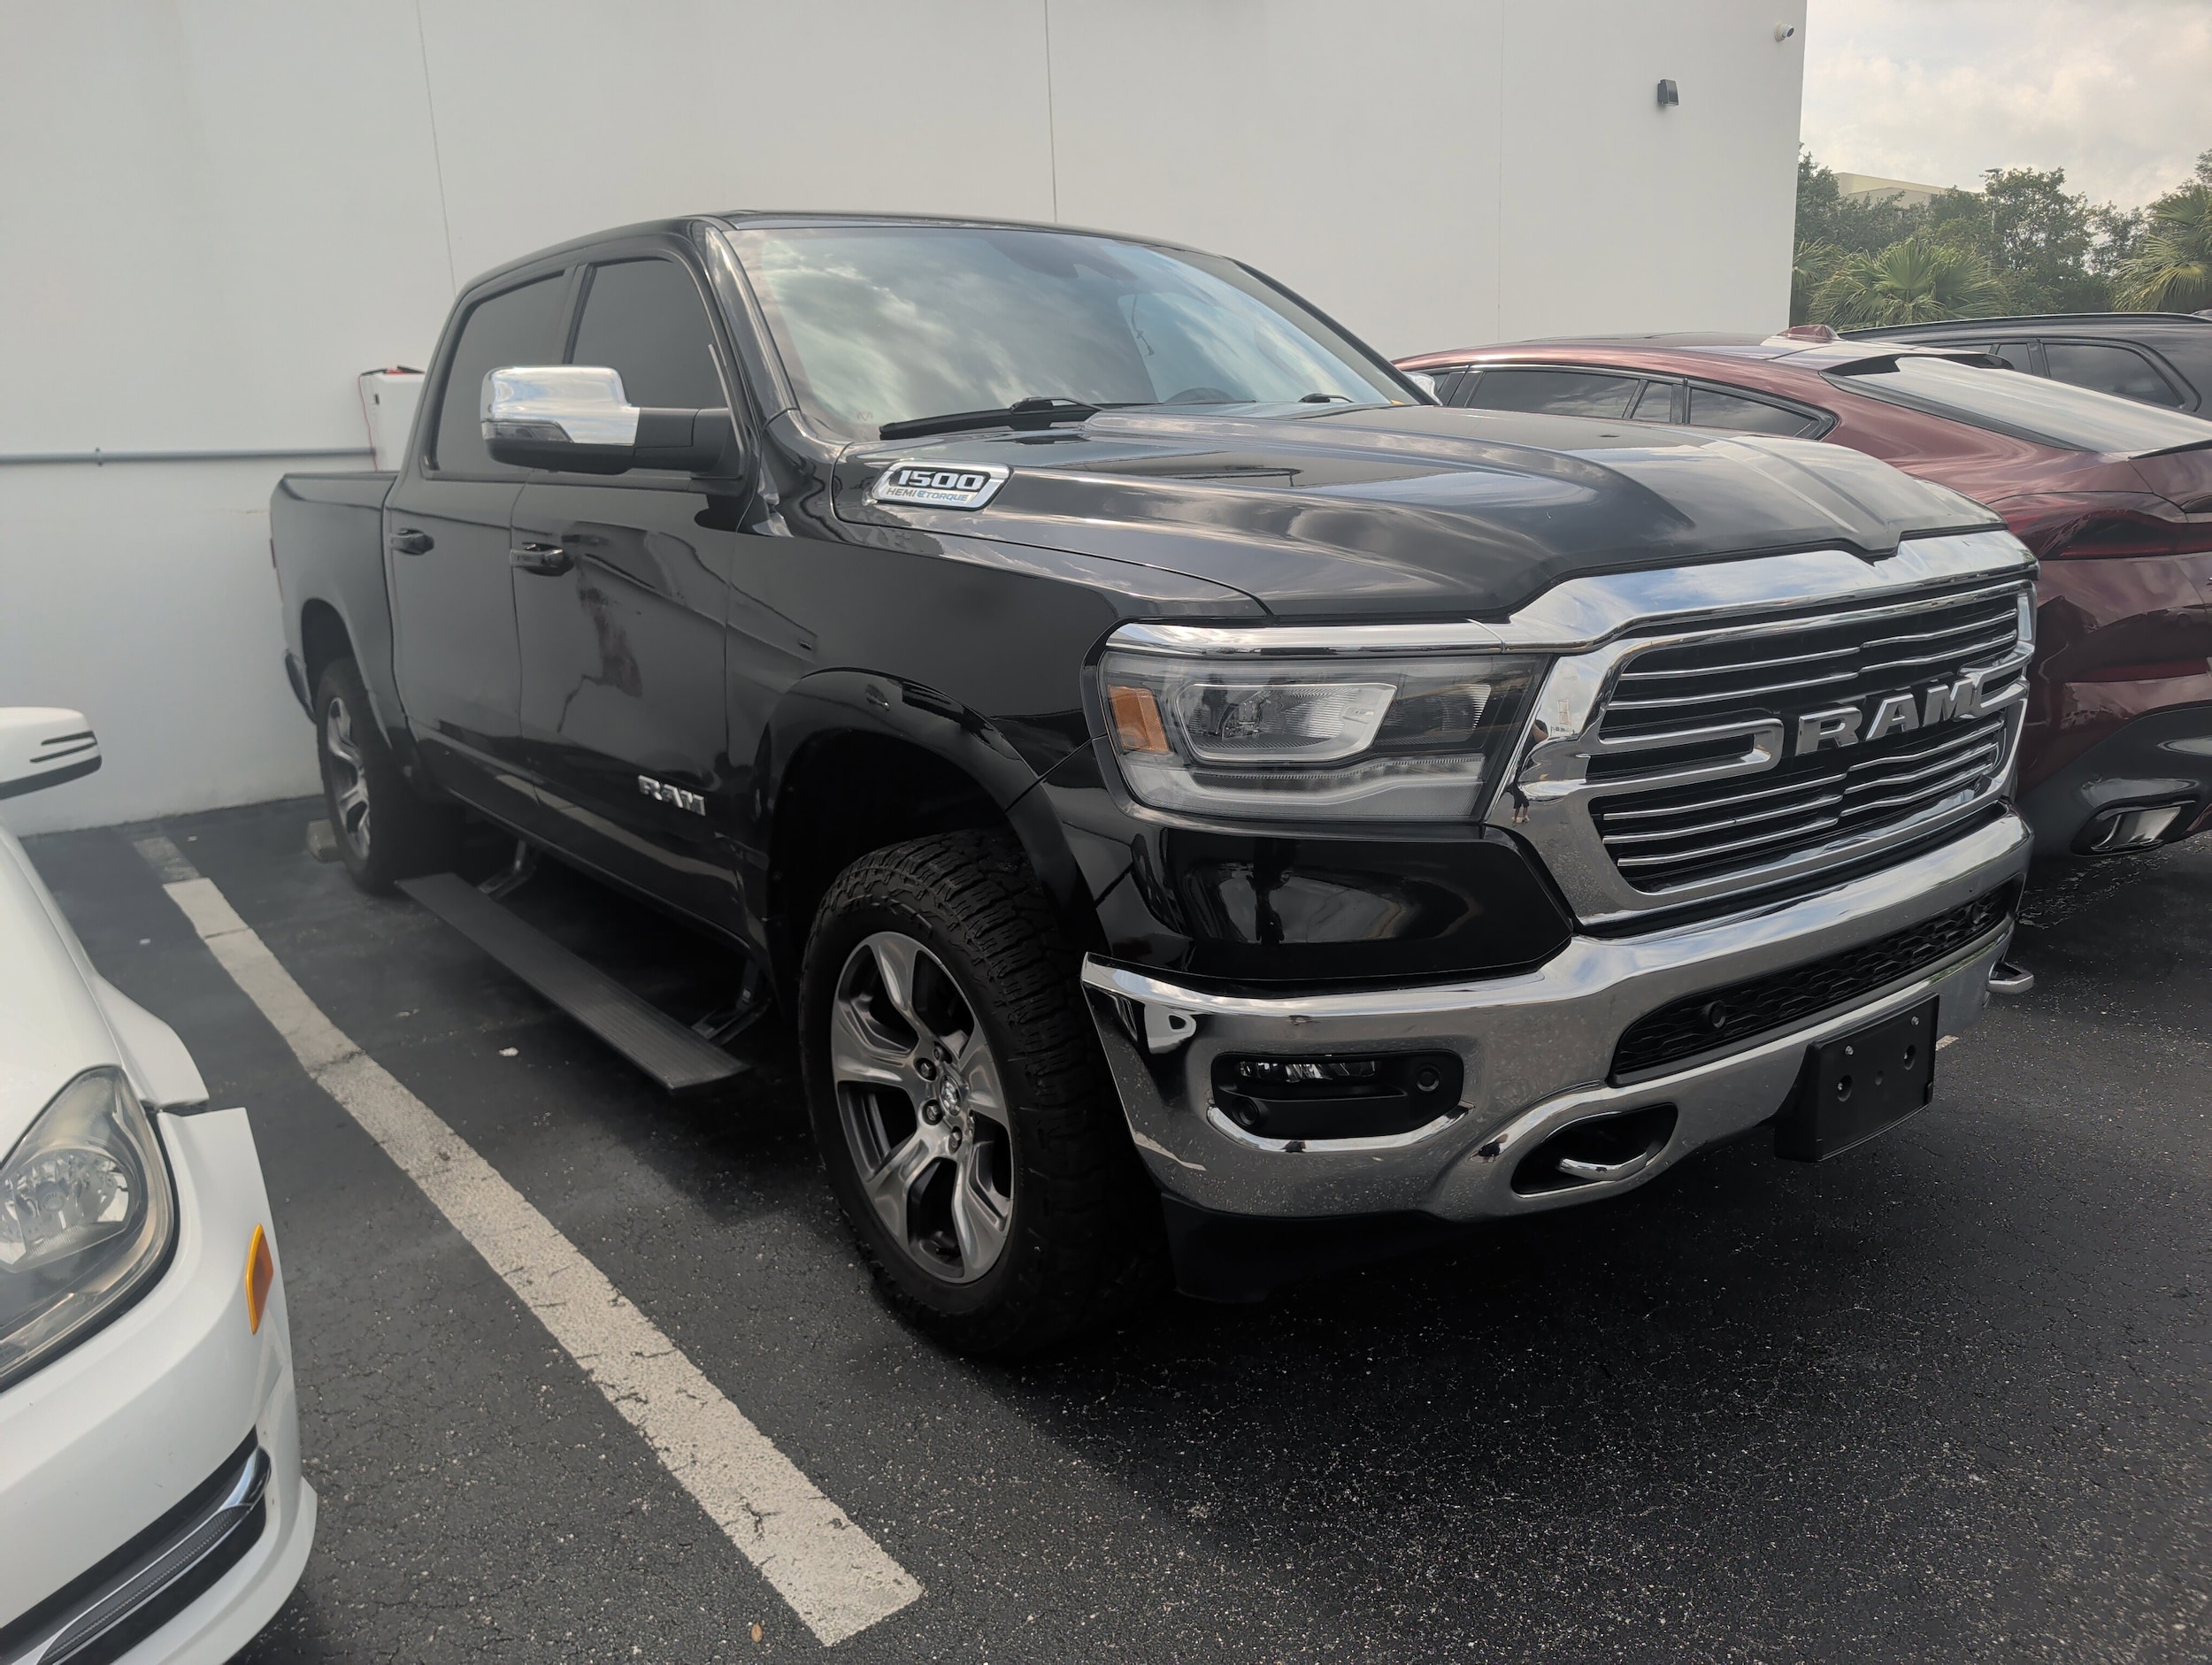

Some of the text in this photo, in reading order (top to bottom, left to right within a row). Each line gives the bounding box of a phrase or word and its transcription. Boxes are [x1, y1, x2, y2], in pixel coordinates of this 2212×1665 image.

[886, 487, 916, 497] HEMI
[897, 469, 985, 491] 1500
[1795, 676, 1980, 756] RAM
[638, 774, 706, 817] RAM
